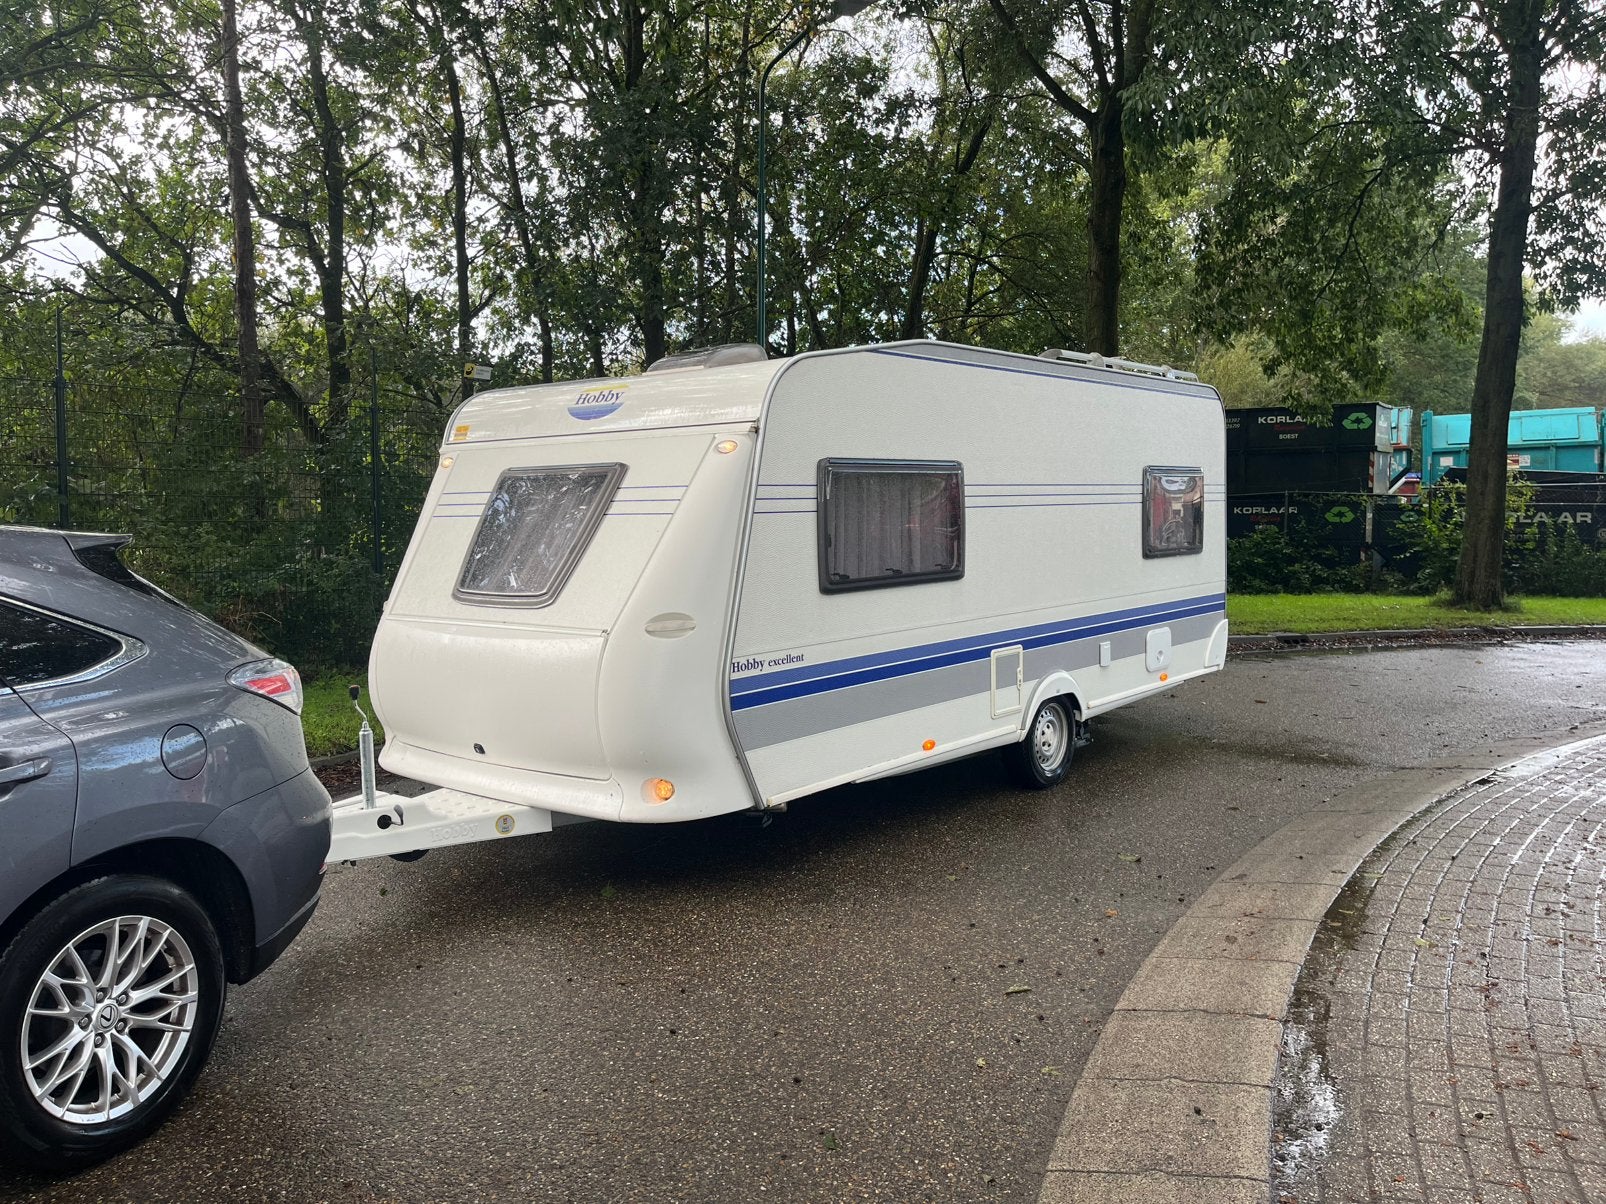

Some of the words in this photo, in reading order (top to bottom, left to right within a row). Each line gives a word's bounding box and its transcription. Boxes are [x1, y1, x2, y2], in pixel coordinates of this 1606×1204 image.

[575, 389, 625, 406] Hobby
[1258, 415, 1306, 424] KORLA
[1233, 506, 1298, 514] KORLAAR
[732, 658, 765, 673] Hobby
[768, 653, 804, 666] excellent
